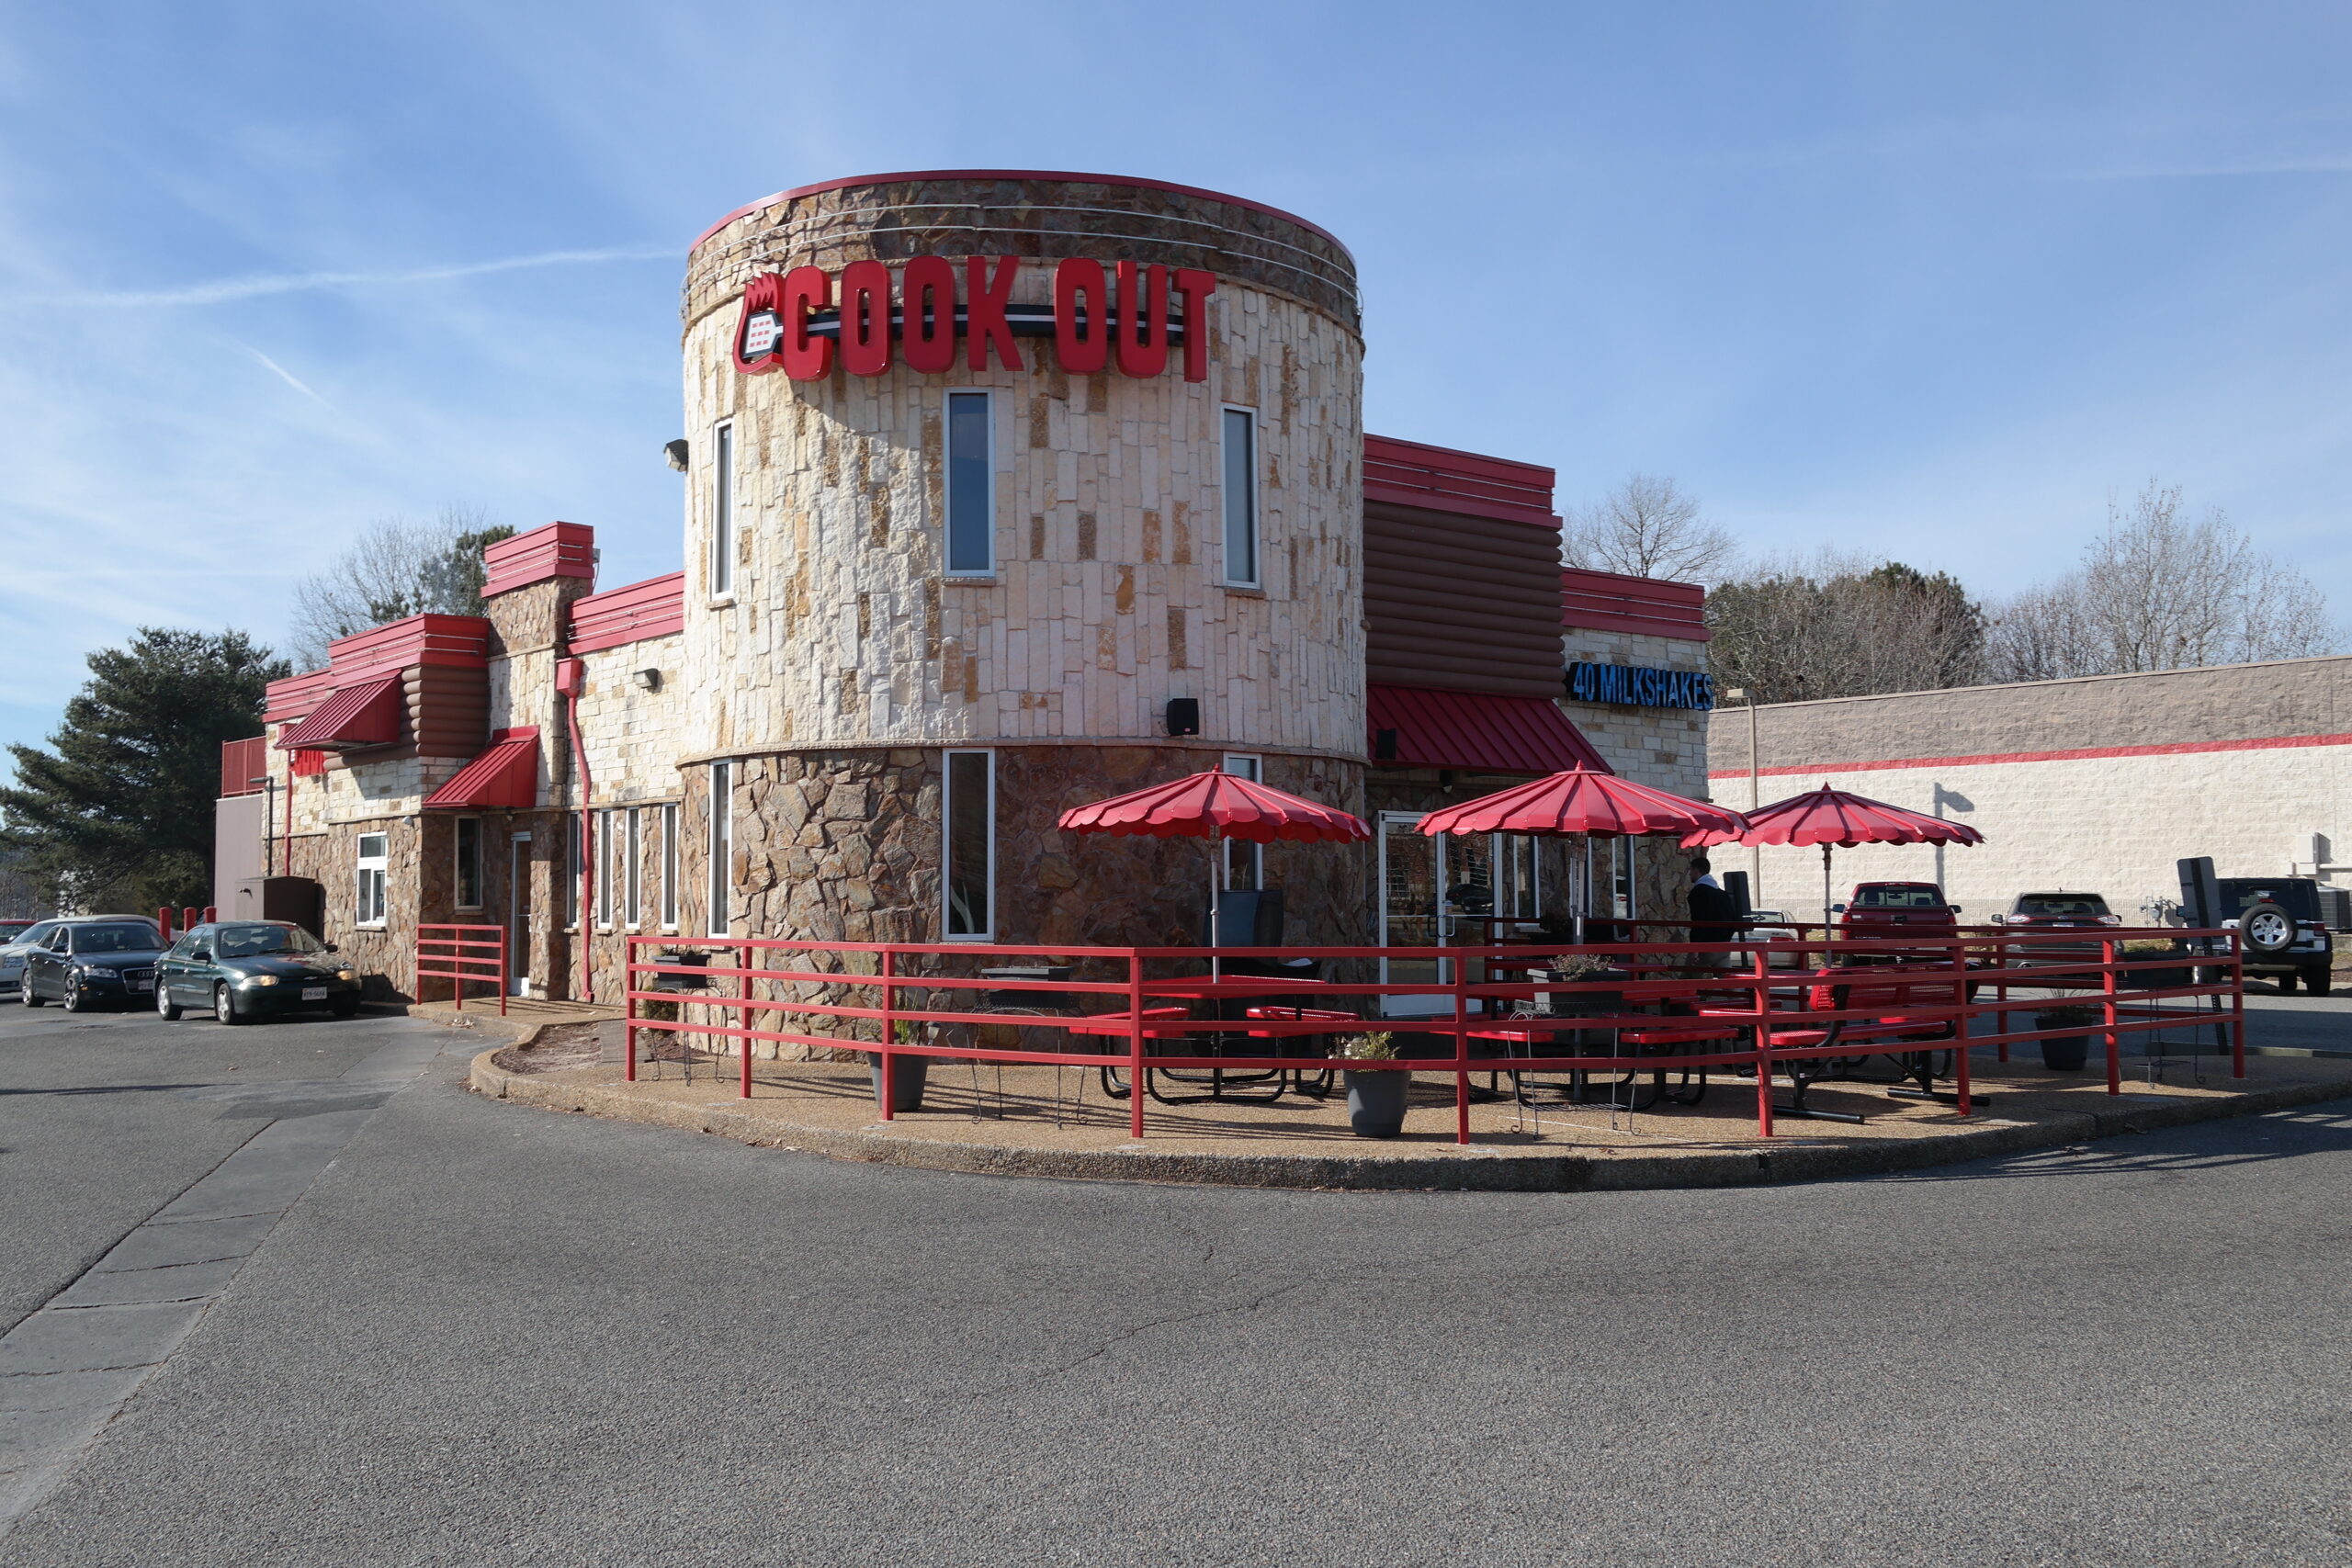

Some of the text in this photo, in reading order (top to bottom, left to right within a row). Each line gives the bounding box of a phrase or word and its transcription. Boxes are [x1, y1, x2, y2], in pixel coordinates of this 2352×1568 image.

[783, 255, 1216, 383] COOK OUT
[1573, 661, 1713, 711] 40 MILKSHAKES
